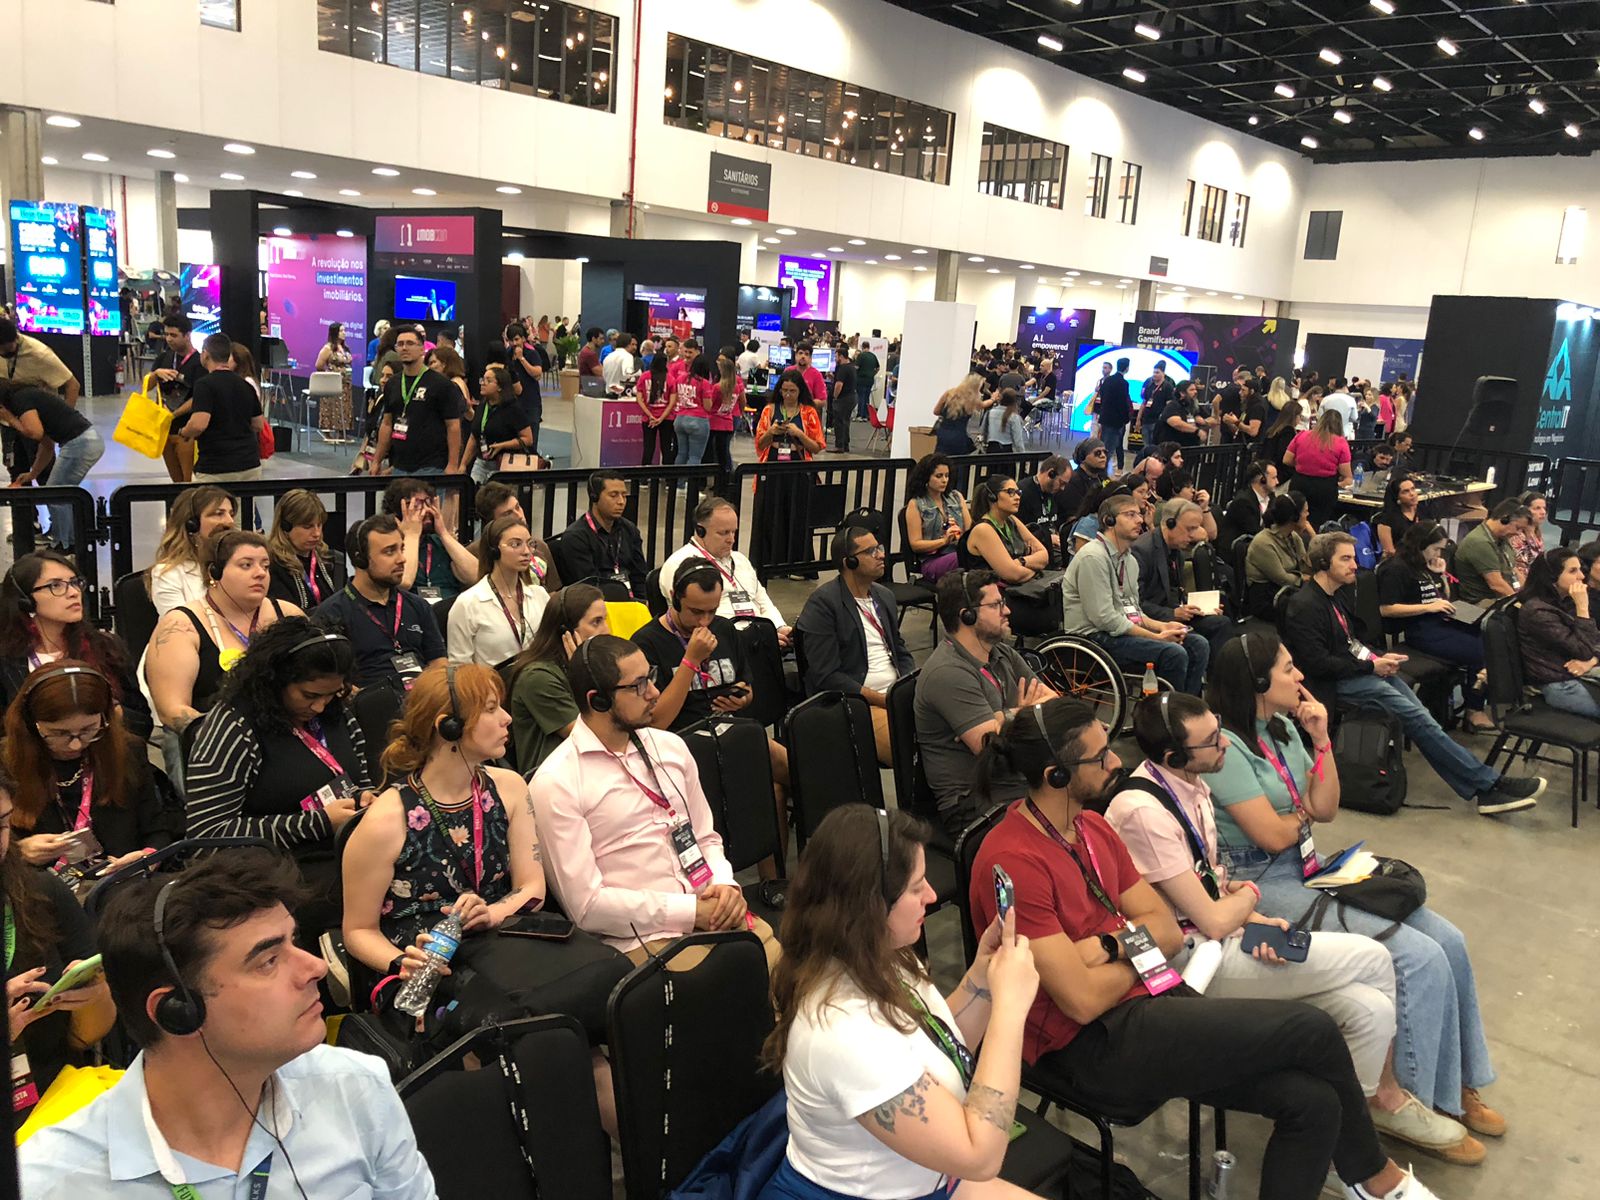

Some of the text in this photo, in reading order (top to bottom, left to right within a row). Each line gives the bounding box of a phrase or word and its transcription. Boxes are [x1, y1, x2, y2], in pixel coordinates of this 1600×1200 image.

[723, 169, 759, 186] SANITÁRIOS
[311, 258, 364, 271] A revolução nos
[317, 273, 364, 286] investimentos
[323, 288, 364, 302] imobiliários.
[1138, 326, 1160, 336] Brand
[1137, 334, 1183, 345] Gamification
[1031, 342, 1069, 351] empowered
